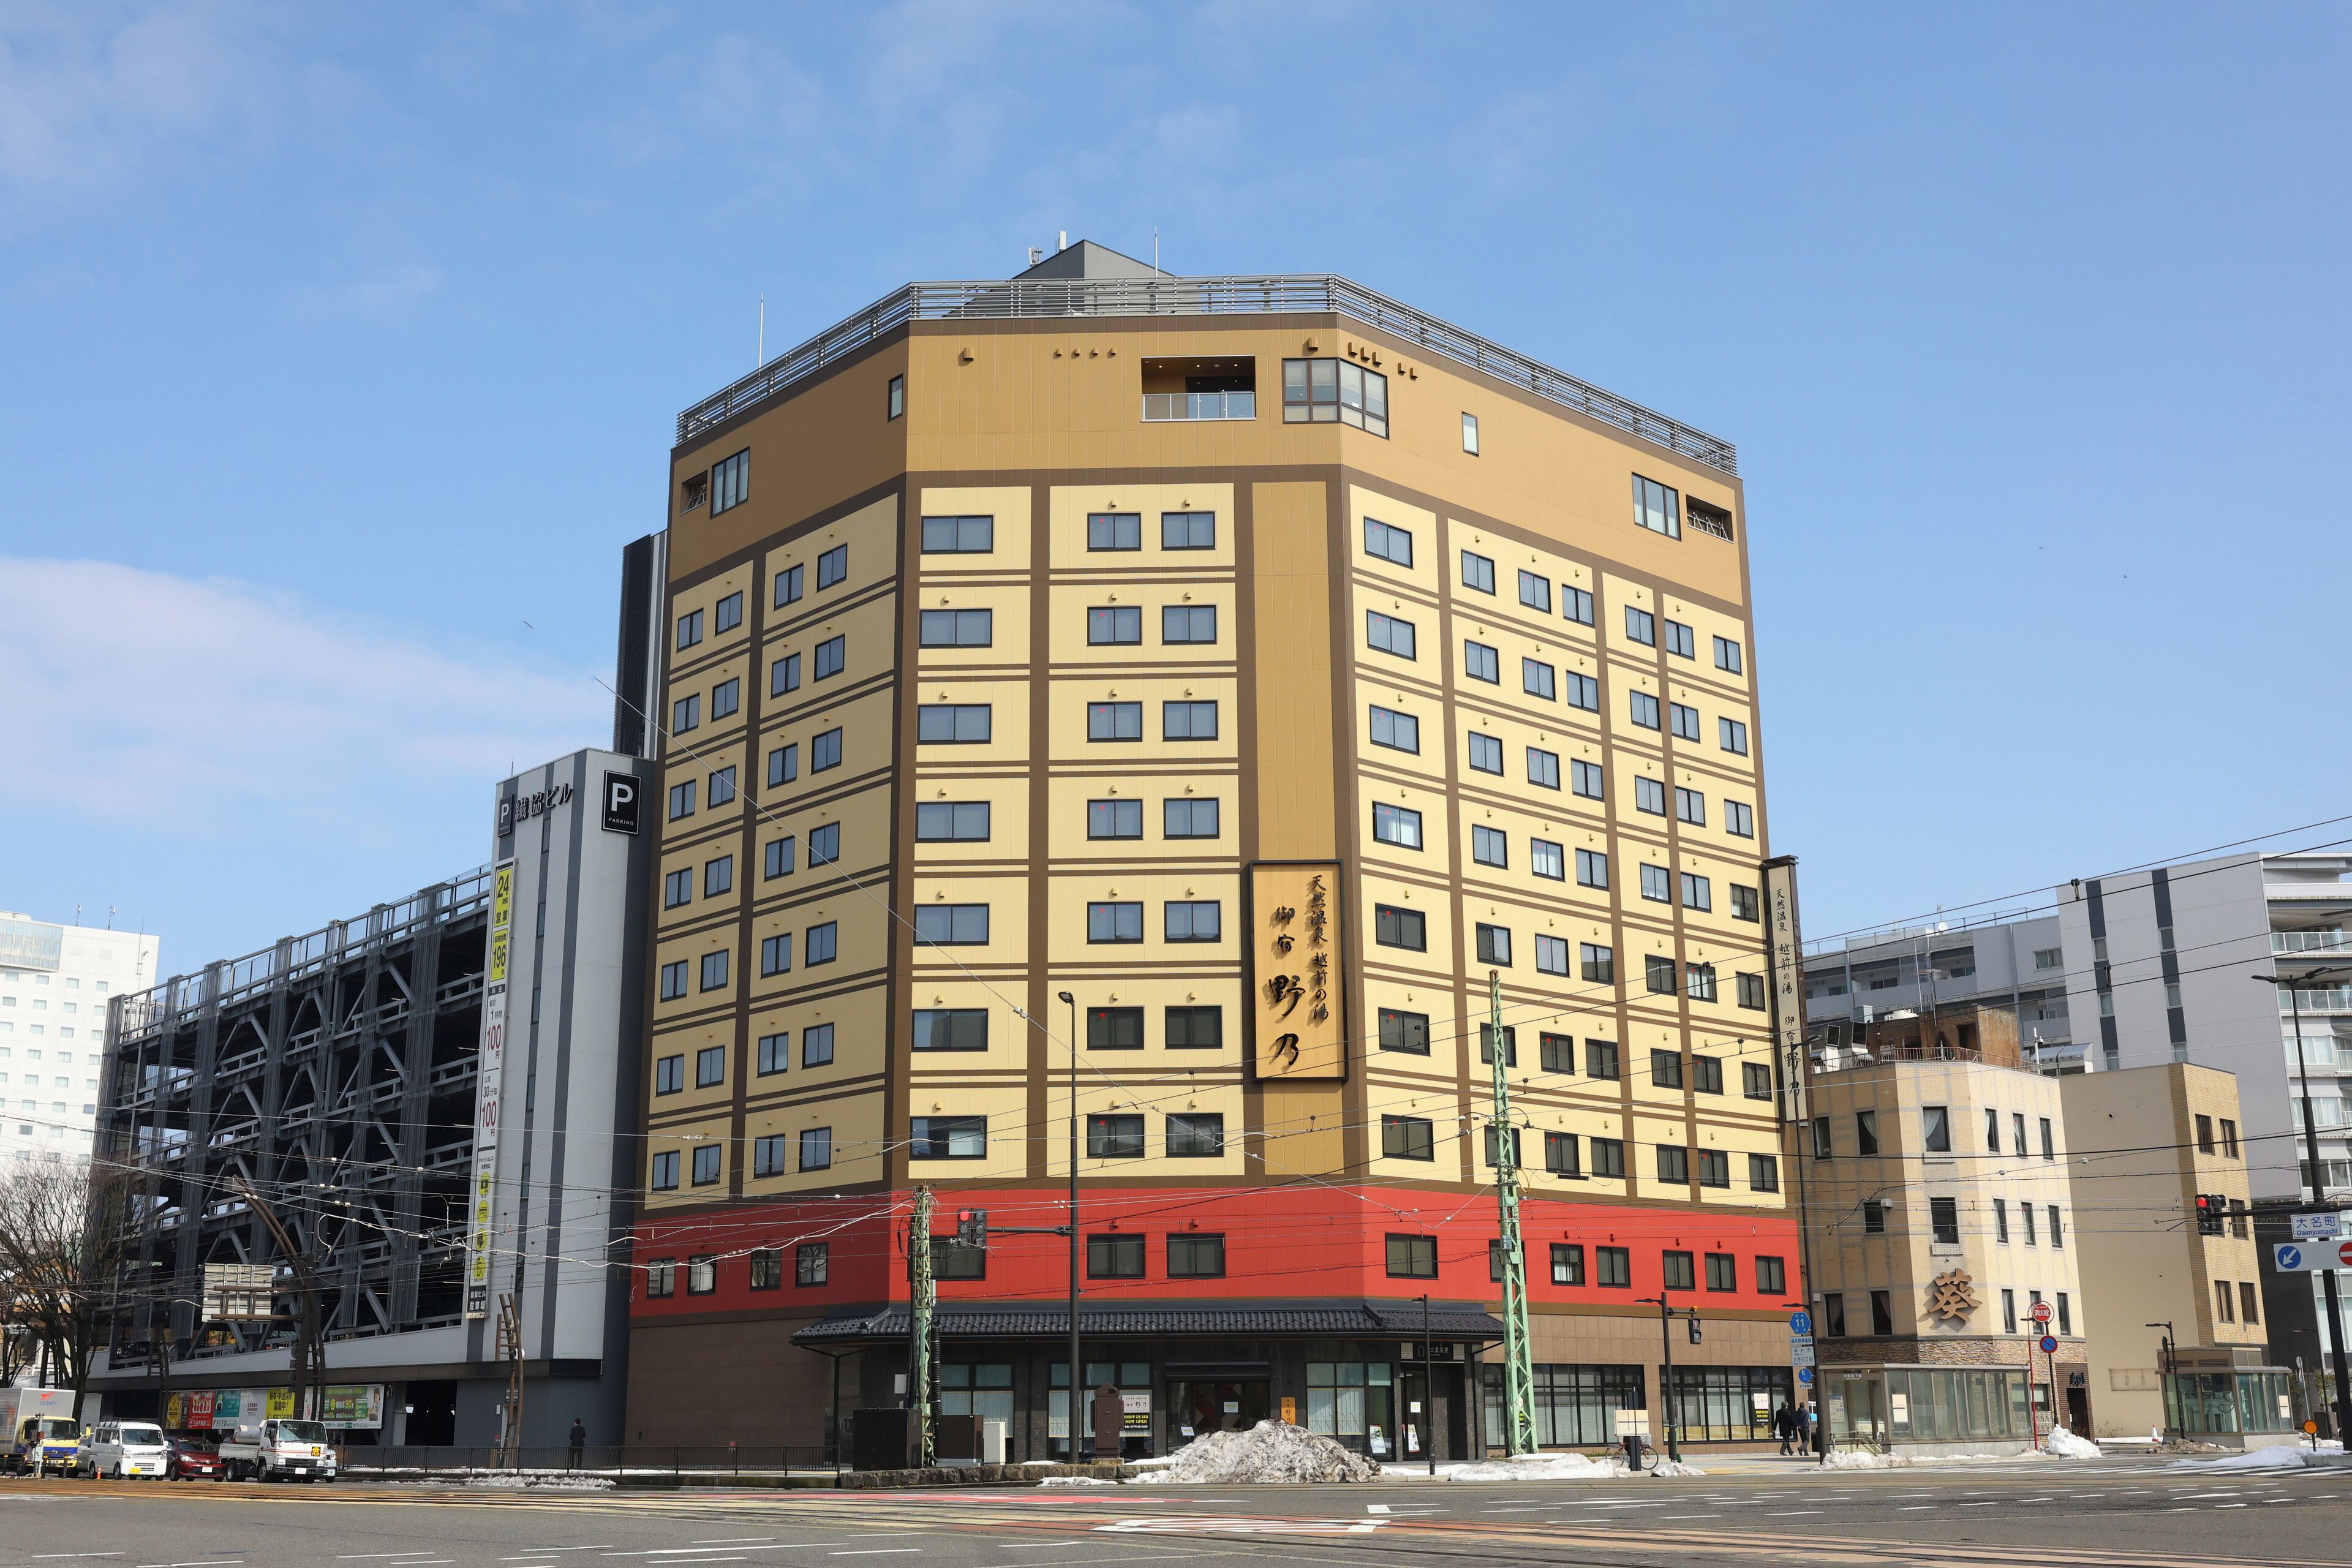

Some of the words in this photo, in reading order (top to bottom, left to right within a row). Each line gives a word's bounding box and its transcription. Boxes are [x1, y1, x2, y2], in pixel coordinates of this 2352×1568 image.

[611, 783, 633, 812] P
[500, 803, 509, 823] P
[497, 873, 509, 899] 24
[496, 910, 508, 924] 営業
[1310, 875, 1328, 944] 天然温泉
[1776, 889, 1788, 932] 天然温泉
[494, 933, 507, 944] 収容台数
[493, 944, 506, 969] 196
[1778, 943, 1793, 994] 越前の湯
[491, 985, 502, 995] 料金
[1312, 952, 1329, 1020] 越前の湯
[490, 1009, 503, 1020] 1時間
[486, 1023, 502, 1051] 100
[495, 1050, 500, 1060] 円
[482, 1100, 497, 1128] 100
[491, 1128, 495, 1137] 円
[2296, 1216, 2335, 1229] 大名町
[2297, 1228, 2338, 1237] Daimyomachi
[1929, 1268, 1983, 1322] 葵
[469, 1300, 486, 1311] 駐車場
[1795, 1318, 1804, 1328] 11
[312, 1447, 320, 1457] 危
